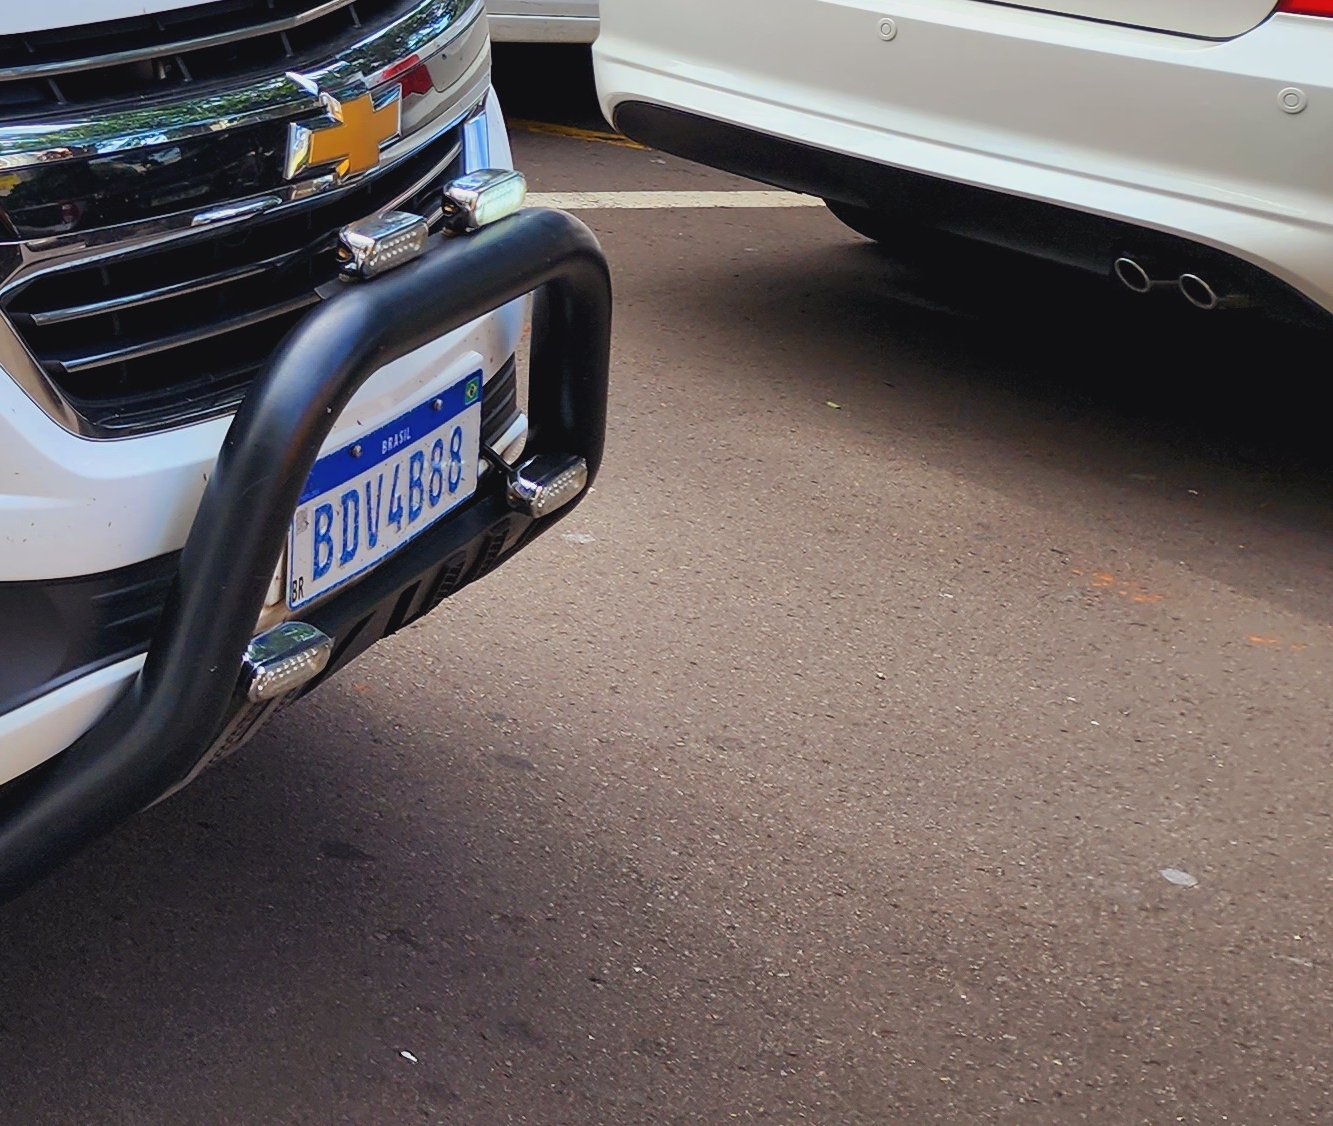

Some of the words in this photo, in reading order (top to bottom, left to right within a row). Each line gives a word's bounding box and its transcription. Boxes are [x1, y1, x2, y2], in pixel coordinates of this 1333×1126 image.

[381, 427, 412, 454] BRASIL
[311, 424, 463, 581] BDV4B88
[291, 575, 305, 604] BR
